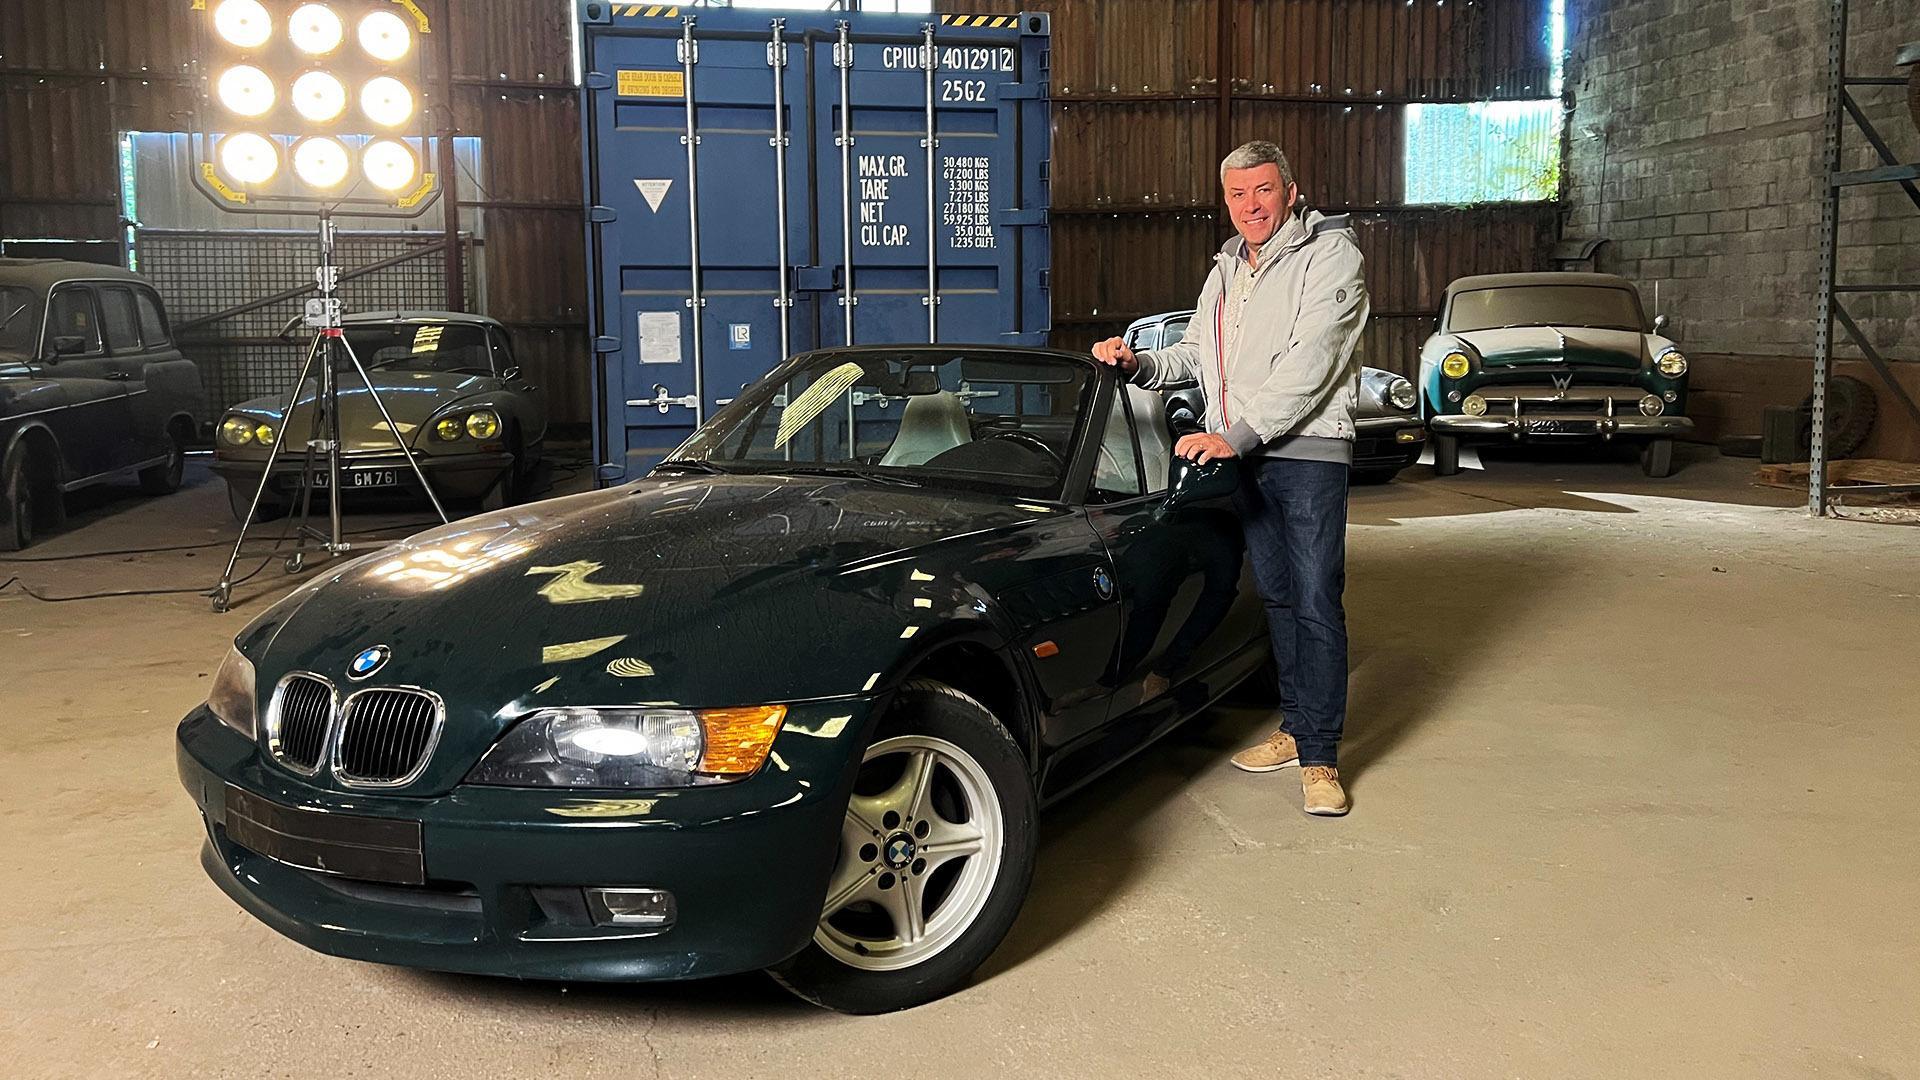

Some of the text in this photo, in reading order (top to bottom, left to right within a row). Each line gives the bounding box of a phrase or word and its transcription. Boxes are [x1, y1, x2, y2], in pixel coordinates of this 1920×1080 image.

[883, 47, 917, 69] CPIU
[942, 48, 996, 70] 401291
[942, 80, 986, 102] 25G2
[943, 157, 989, 168] 30.480 KGS
[943, 168, 989, 180] 67.200 LBS
[859, 178, 889, 200] TARE
[949, 180, 989, 191] 3.300 KGS
[949, 191, 989, 203] 7.275 LBS
[860, 201, 885, 223] NET
[943, 203, 989, 214] 27.180 KGS
[943, 214, 989, 225] 59.925 LBS
[861, 224, 910, 246] CU. CAP.
[955, 226, 974, 237] 35.0
[950, 237, 974, 248] 1.235
